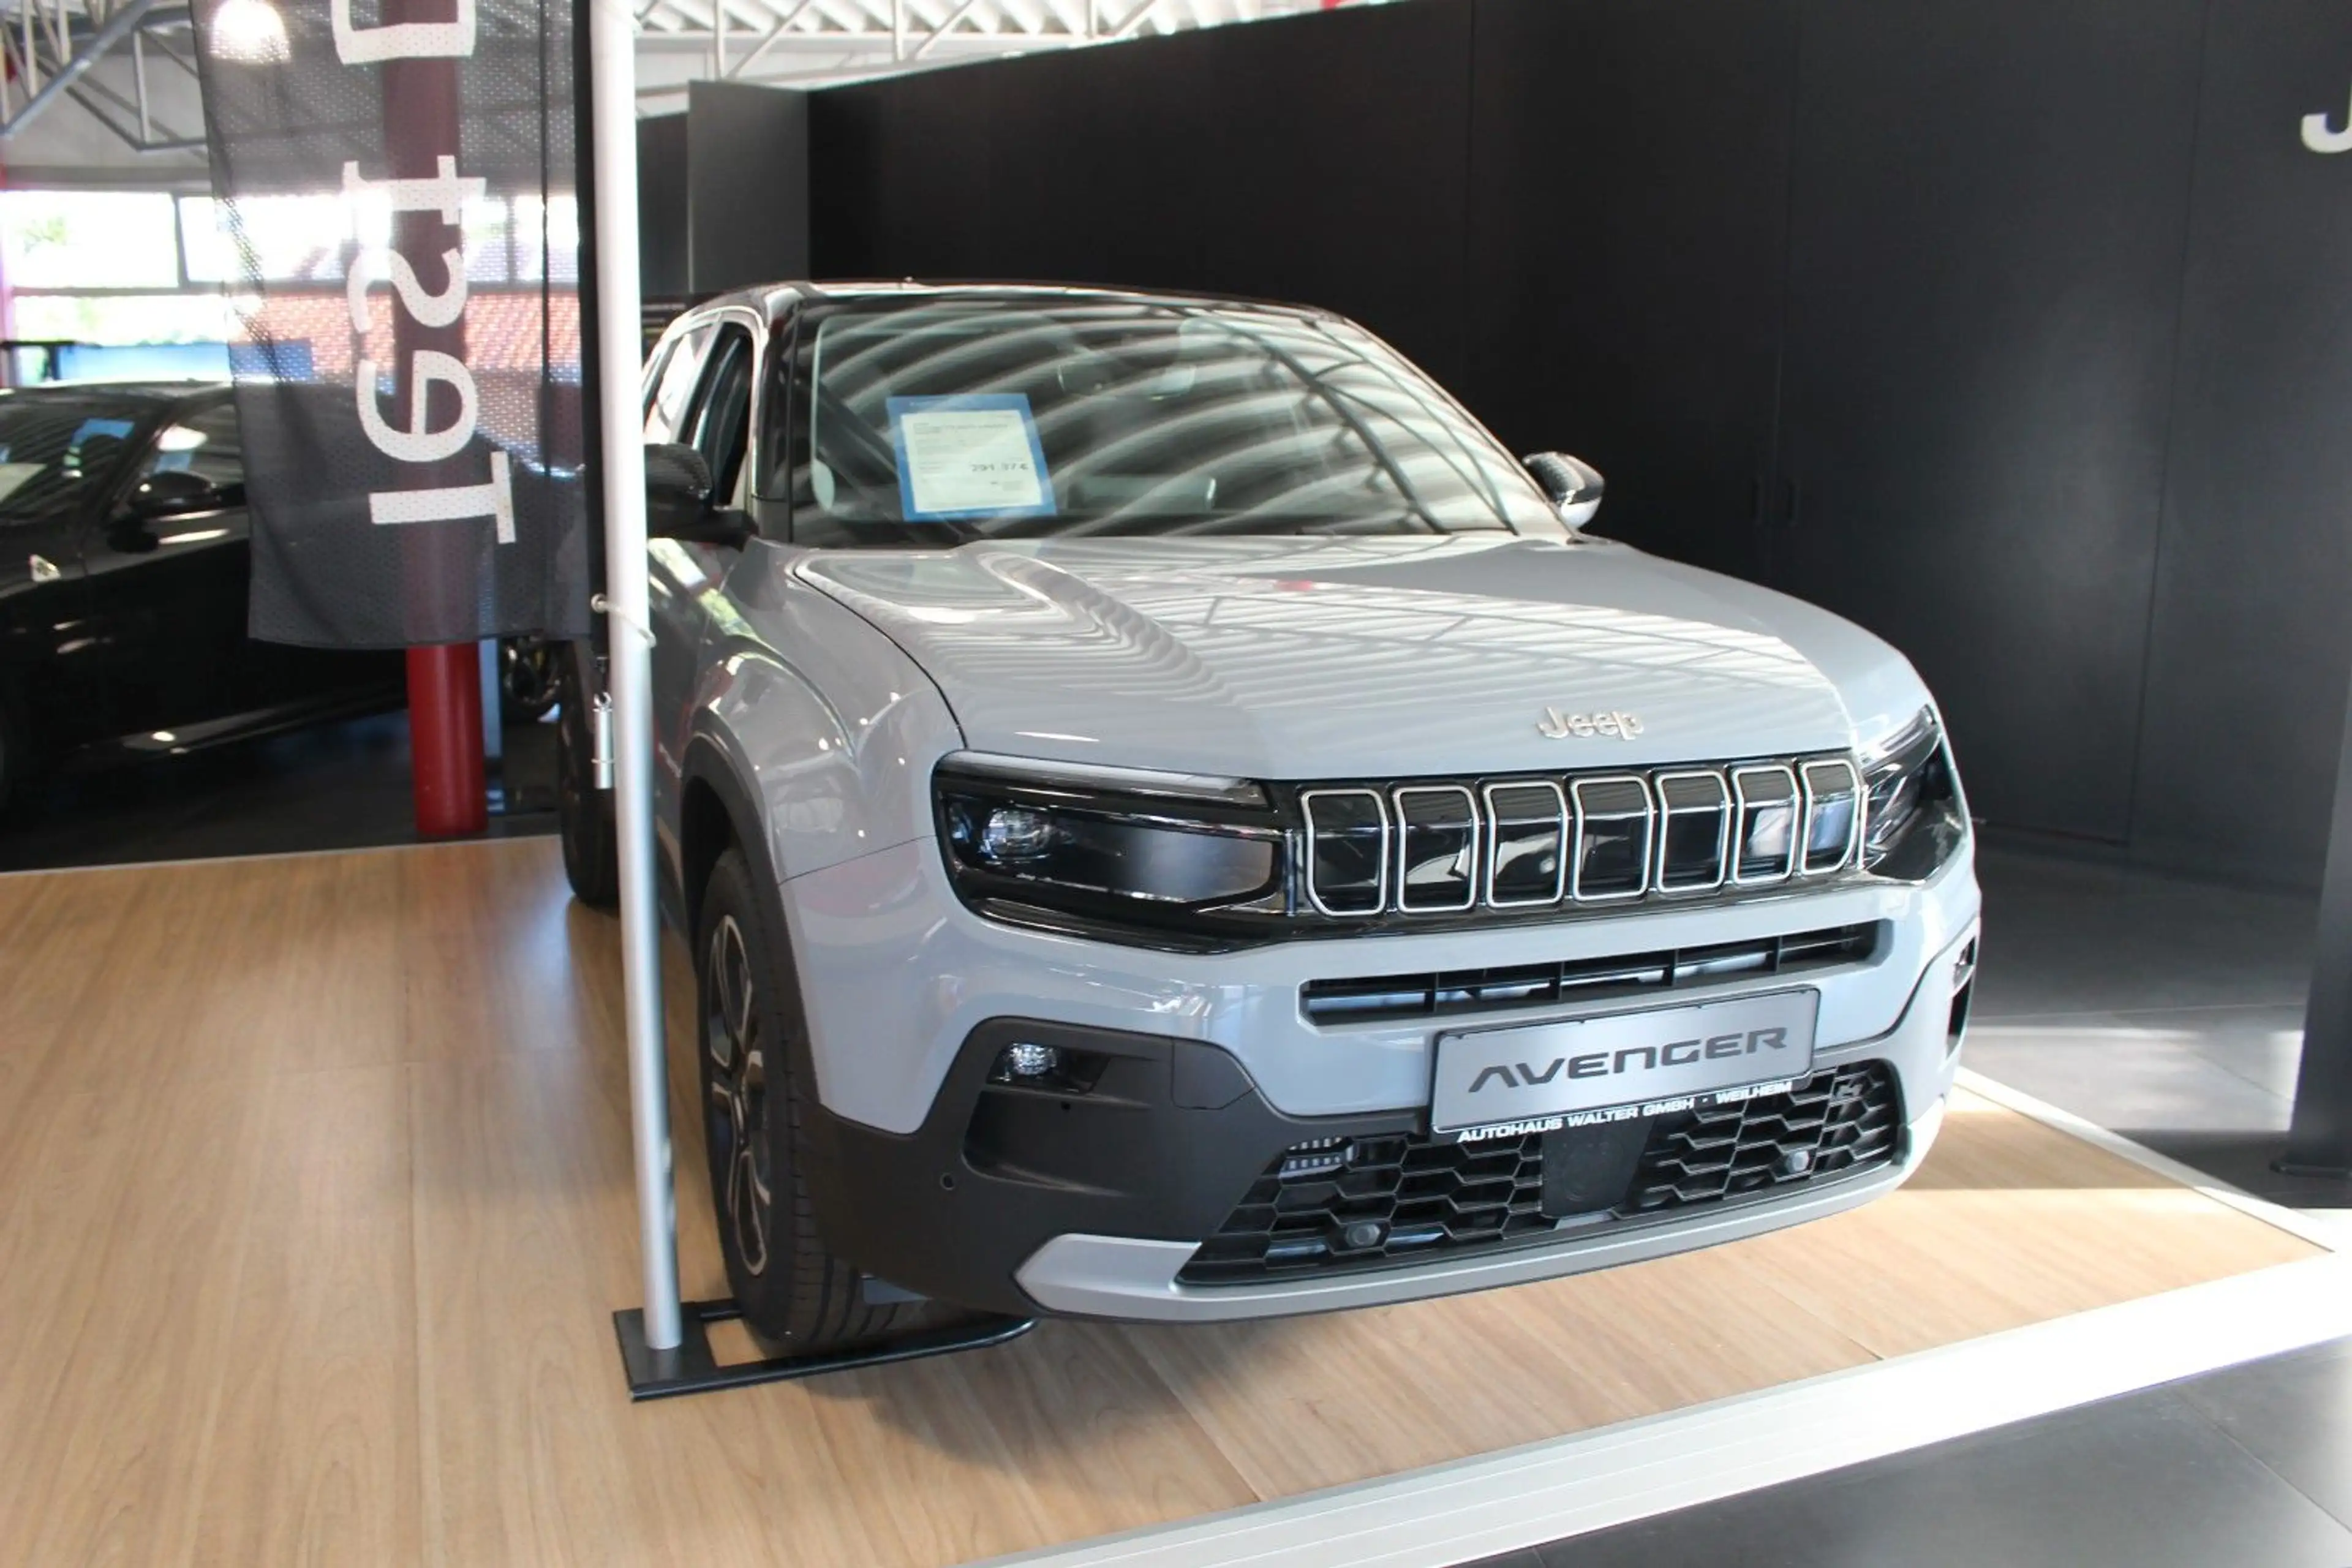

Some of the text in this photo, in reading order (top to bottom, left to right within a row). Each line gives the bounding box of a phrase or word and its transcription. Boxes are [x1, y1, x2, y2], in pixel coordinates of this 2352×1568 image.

[1536, 706, 1645, 741] Jeep
[1468, 1027, 1787, 1093] AVENGER
[1457, 1117, 1562, 1143] AUTOHAUS
[1568, 1105, 1638, 1128] WALTER
[1642, 1096, 1695, 1117] GMBH
[1715, 1080, 1793, 1104] WEILHEIM
